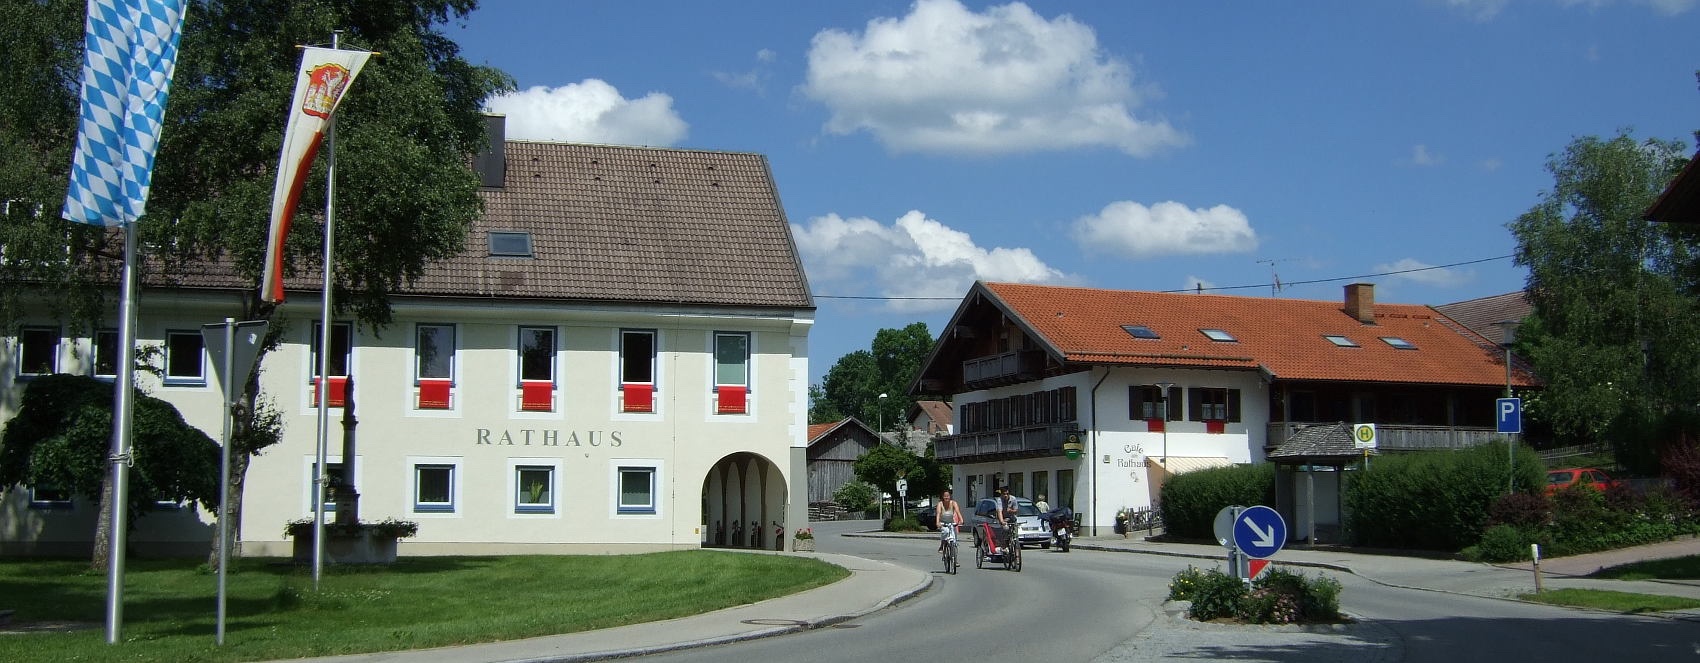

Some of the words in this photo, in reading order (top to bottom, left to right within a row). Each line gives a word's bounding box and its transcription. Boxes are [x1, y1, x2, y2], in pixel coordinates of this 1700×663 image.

[1501, 402, 1515, 422] P
[475, 428, 623, 447] RATHAUS
[1360, 428, 1369, 439] H
